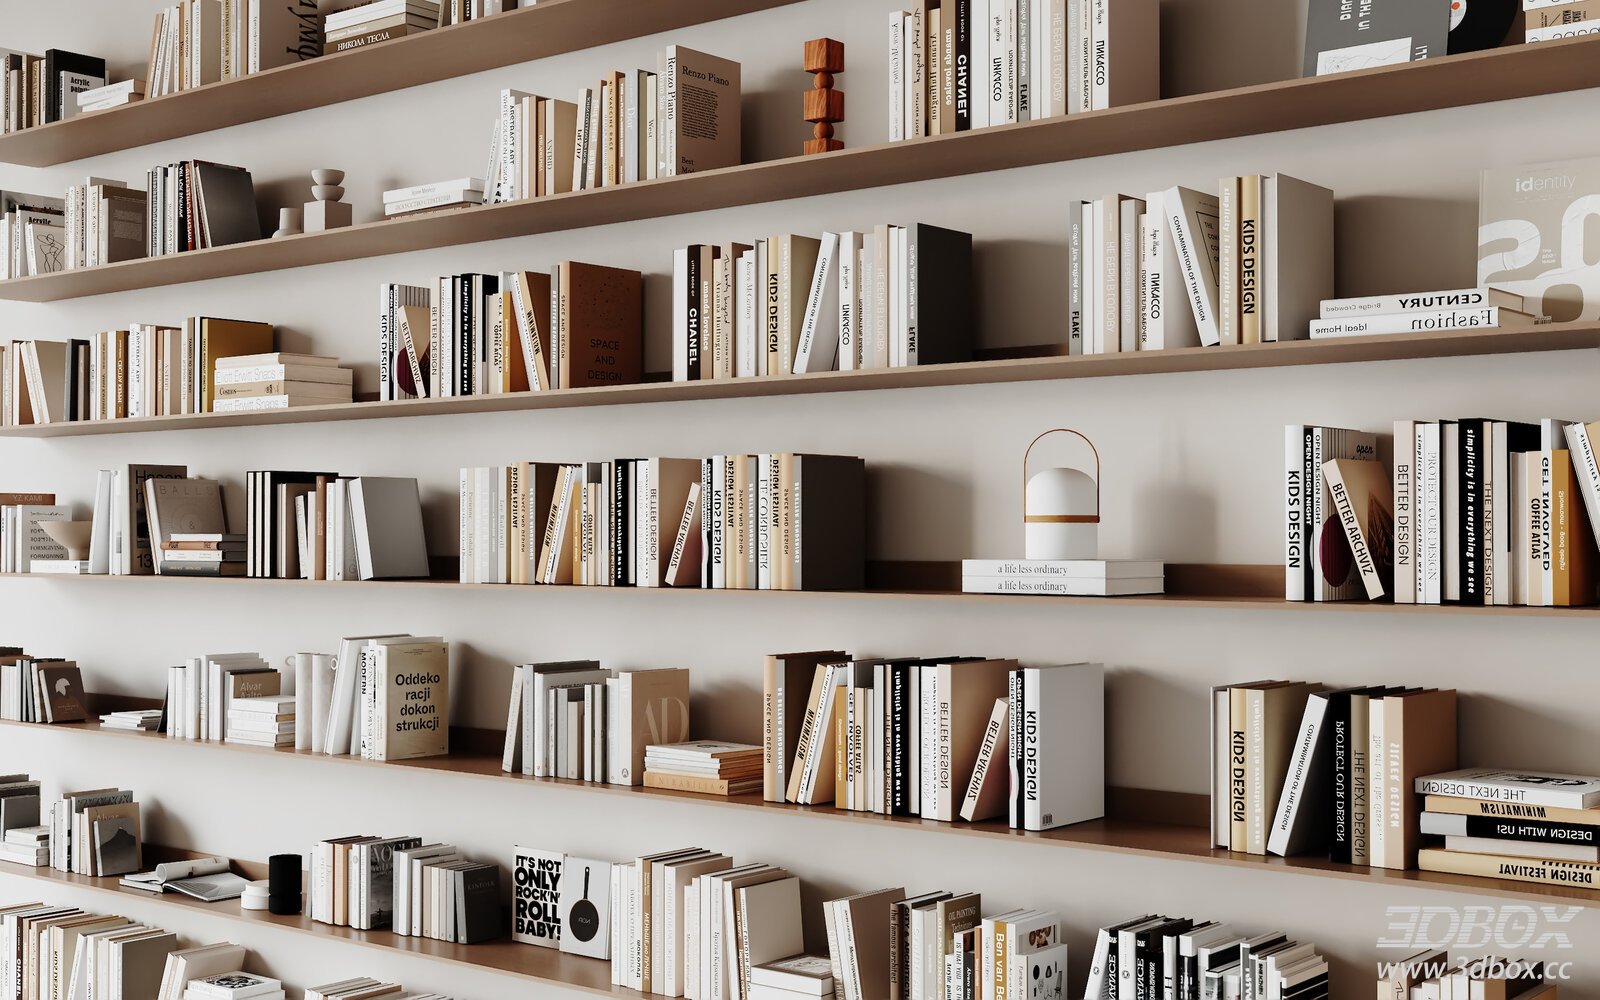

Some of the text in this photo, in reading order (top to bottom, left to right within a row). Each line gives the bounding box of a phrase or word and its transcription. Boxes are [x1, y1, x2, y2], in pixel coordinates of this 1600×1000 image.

[337, 37, 365, 51] НИКОЛА
[367, 32, 390, 44] ТЕСЛА
[1096, 40, 1105, 86] ПИКАССО
[682, 65, 730, 87] Renzo Piano
[667, 57, 676, 120] Renzo Piano
[1020, 84, 1028, 112] FLAKE
[681, 157, 695, 166] Best
[1515, 174, 1577, 193] identity
[1172, 215, 1207, 322] CONTAMINATION OF THE DESIGN
[1242, 219, 1255, 315] KIDS DESIGN
[1150, 273, 1160, 319] ПИКАССО
[1072, 311, 1080, 339] FLAKE
[590, 338, 620, 350] SPACE
[689, 308, 698, 366] CHANEL
[595, 354, 615, 366] AND
[587, 370, 622, 382] DESIGN
[159, 485, 213, 496] BALLS
[1417, 484, 1424, 492] is
[1417, 496, 1424, 504] in
[1288, 470, 1300, 568] KIDS DESIGN
[1398, 464, 1409, 566] BETTER DESIGN
[1466, 429, 1476, 594] simplicity is in everything we see
[545, 504, 557, 548] MINIMALISM
[1332, 482, 1374, 577] BETTER ARCHVIZ
[1531, 498, 1541, 560] COFFEE ATLAS
[1484, 481, 1492, 596] THE NEXT DESIGN
[1004, 564, 1017, 574] life
[1018, 564, 1033, 574] less
[1034, 564, 1068, 577] ordinary
[1417, 561, 1424, 573] we
[1004, 581, 1017, 591] life
[1018, 581, 1033, 591] less
[1034, 581, 1068, 593] ordinary
[240, 682, 262, 691] Alvar
[395, 673, 440, 686] Oddeko
[405, 687, 431, 702] racji
[400, 703, 435, 716] dokon
[396, 716, 439, 732] strukcji
[797, 709, 815, 760] MINIMALISM
[515, 855, 561, 873] IT'S NOT
[467, 881, 495, 890] KINFOLK
[514, 866, 561, 892] ONLY
[515, 897, 561, 925] ROLL
[515, 917, 561, 941] BABY!
[891, 910, 899, 984] the famous architect
[996, 933, 1005, 956] Ben
[996, 960, 1005, 982] van
